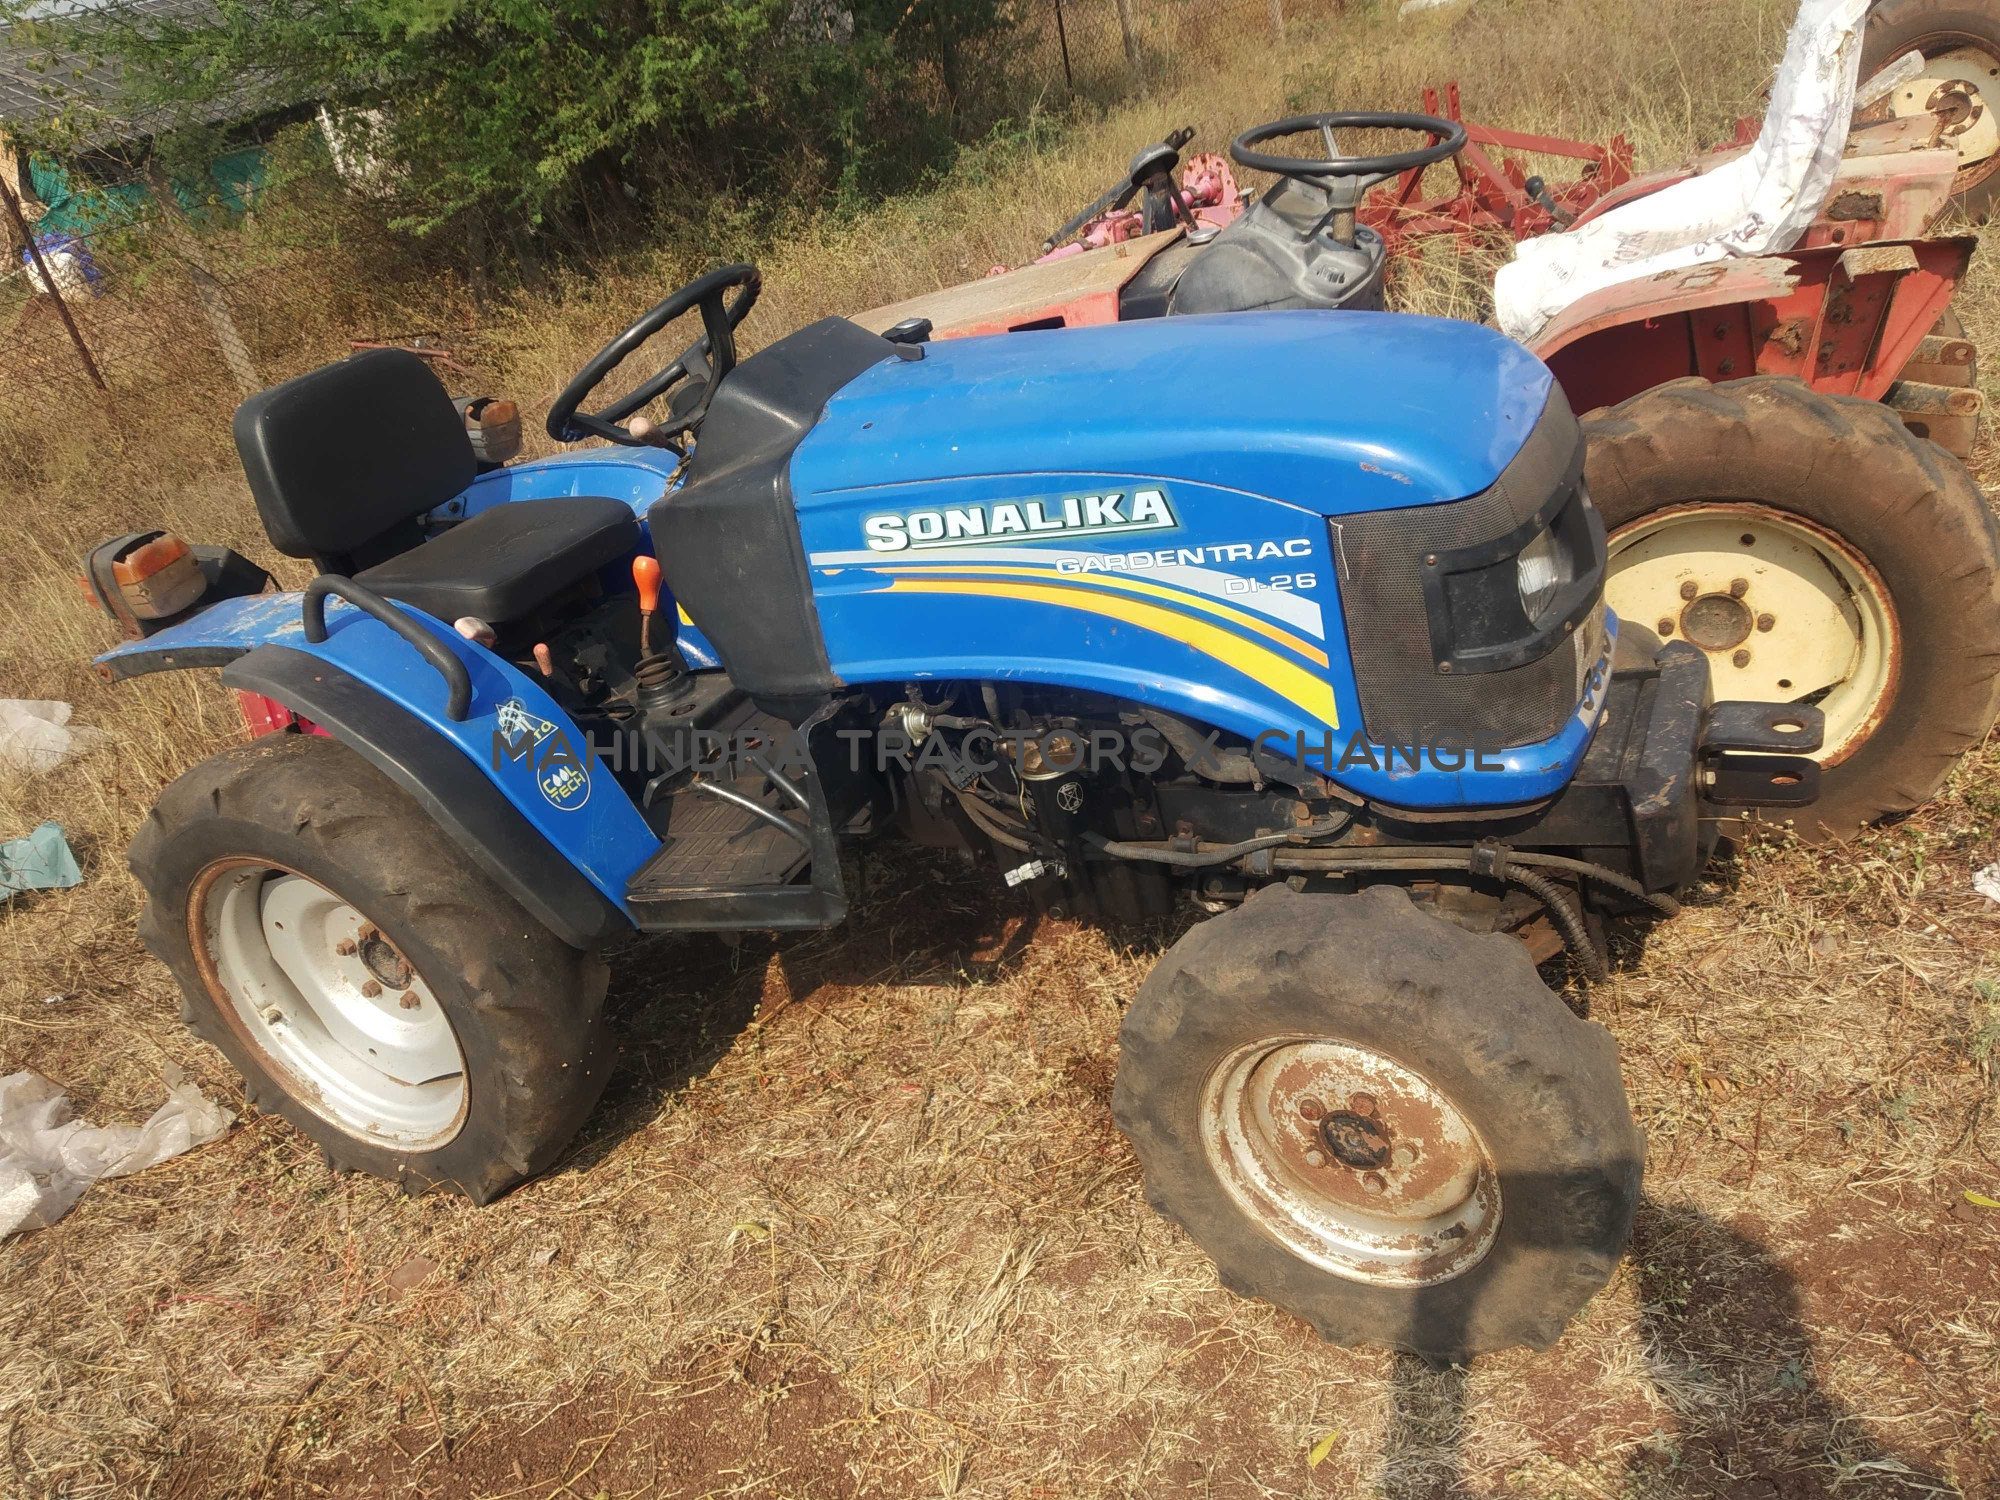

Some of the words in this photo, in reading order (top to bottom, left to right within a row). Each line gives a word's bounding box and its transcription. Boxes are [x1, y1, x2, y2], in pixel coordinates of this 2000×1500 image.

[864, 490, 1178, 553] SONALIKA
[1056, 538, 1312, 575] GARDENTRAC
[1224, 573, 1317, 595] DI-26
[550, 772, 587, 803] TECH
